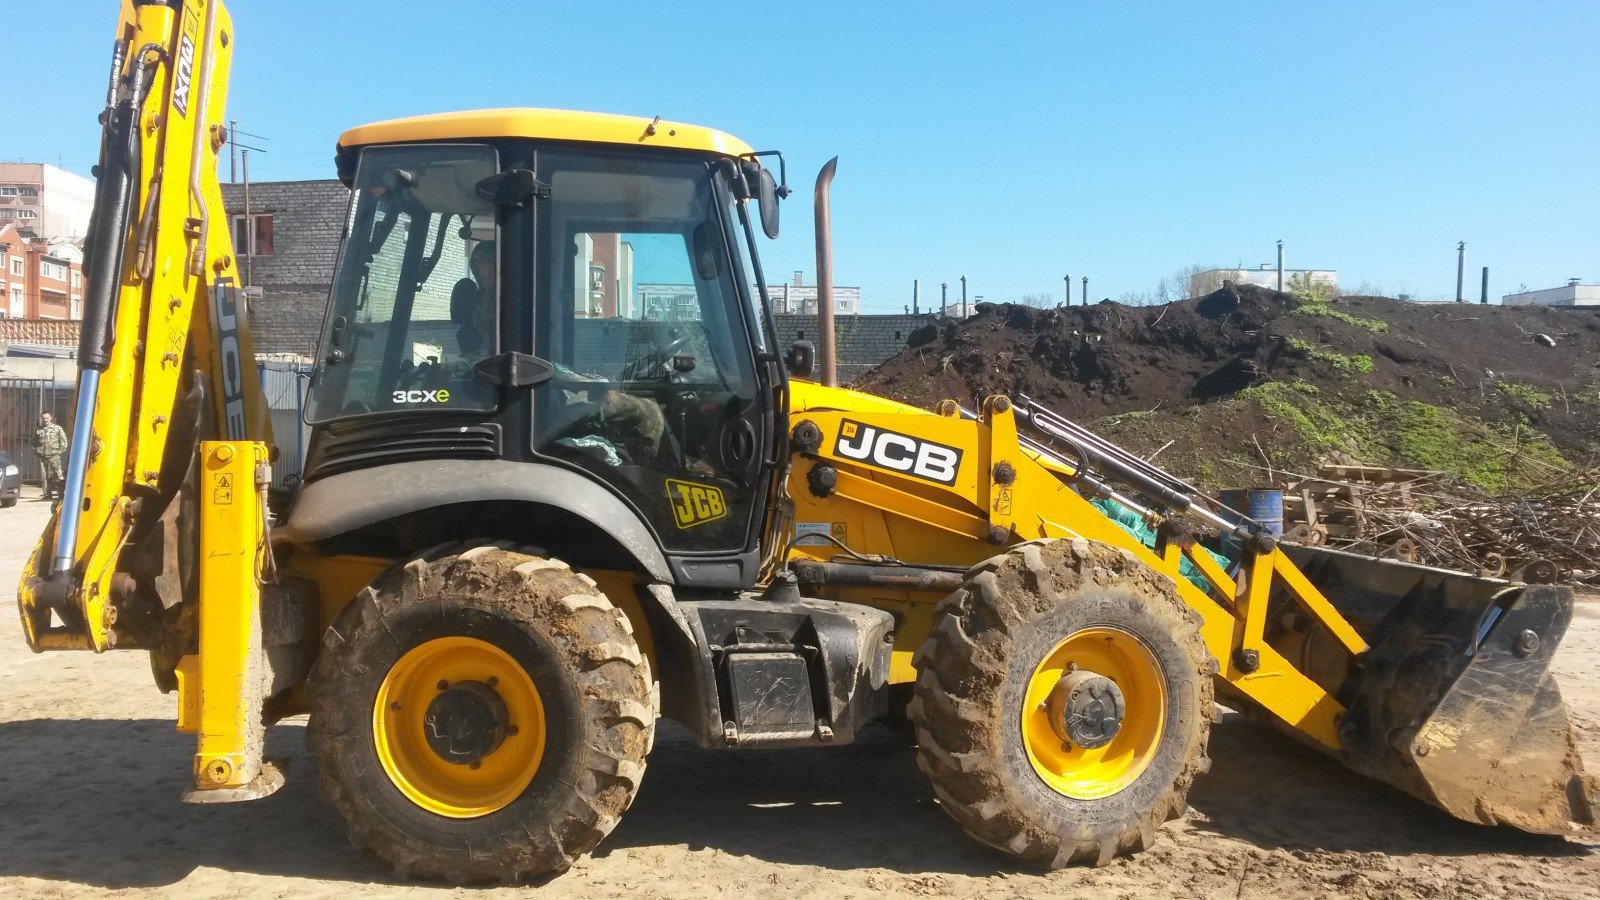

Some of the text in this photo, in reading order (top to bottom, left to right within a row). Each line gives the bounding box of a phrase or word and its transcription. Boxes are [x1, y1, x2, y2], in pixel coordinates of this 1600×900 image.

[392, 389, 450, 403] 3CXe
[838, 427, 958, 482] JCB
[677, 485, 723, 523] JCB
